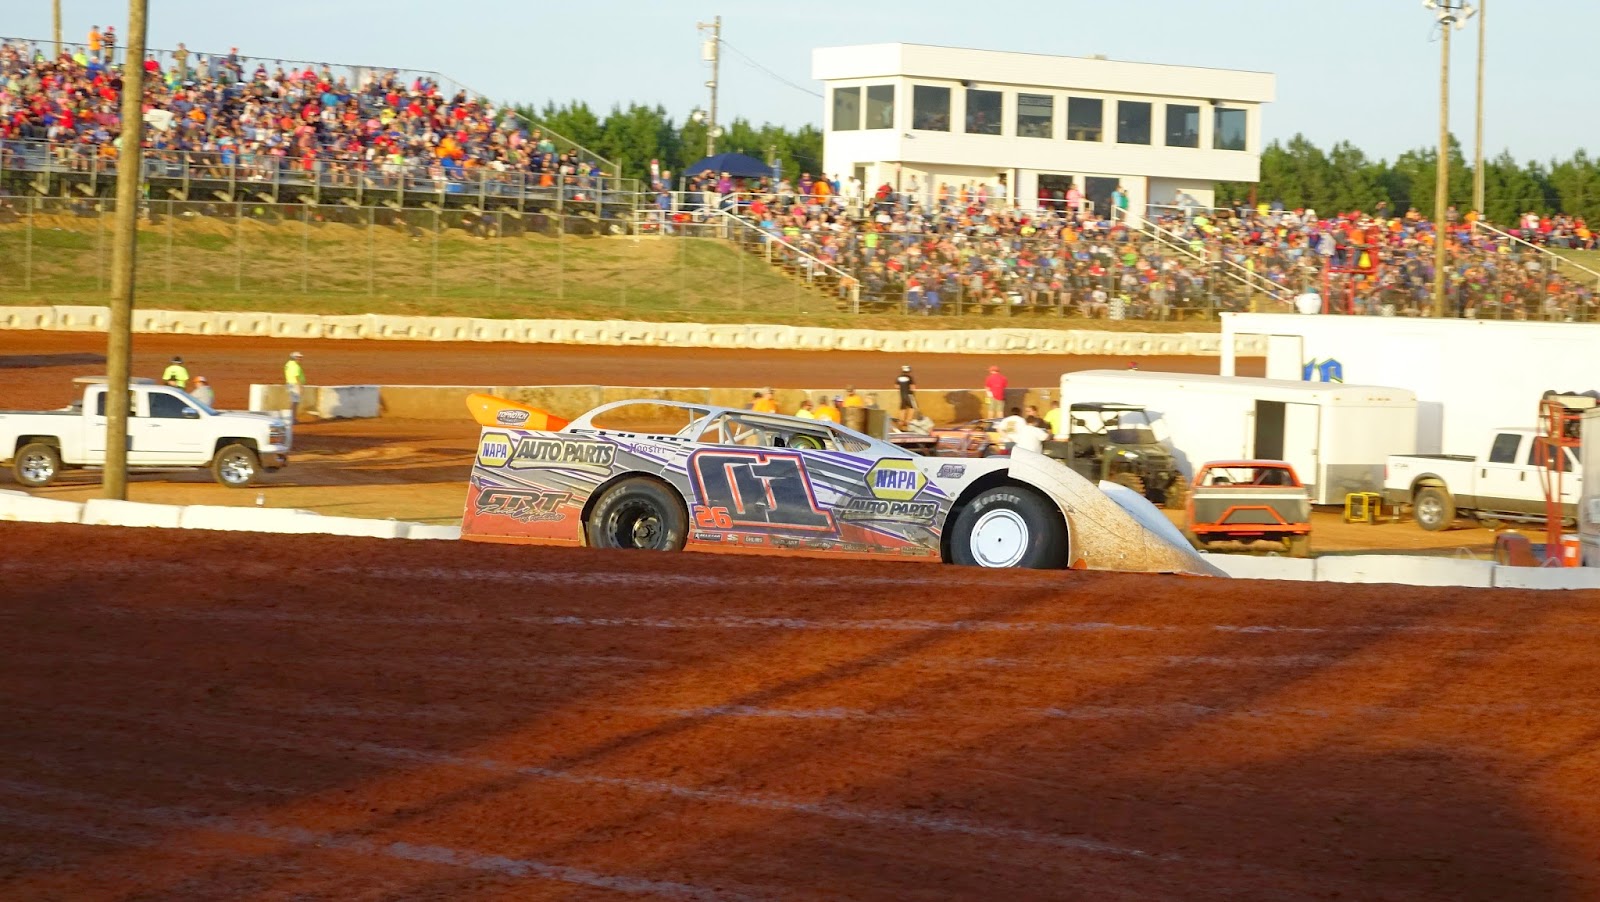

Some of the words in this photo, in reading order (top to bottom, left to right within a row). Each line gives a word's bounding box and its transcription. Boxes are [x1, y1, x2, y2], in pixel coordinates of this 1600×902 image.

[482, 442, 508, 459] NAPA
[515, 440, 563, 462] AUTO
[562, 442, 614, 466] PARTS
[629, 442, 667, 455] Hoosier
[875, 469, 916, 490] NAPA
[475, 489, 571, 514] GRT
[851, 500, 889, 515] AUTO
[888, 502, 935, 519] PARTS
[693, 505, 734, 529] 26
